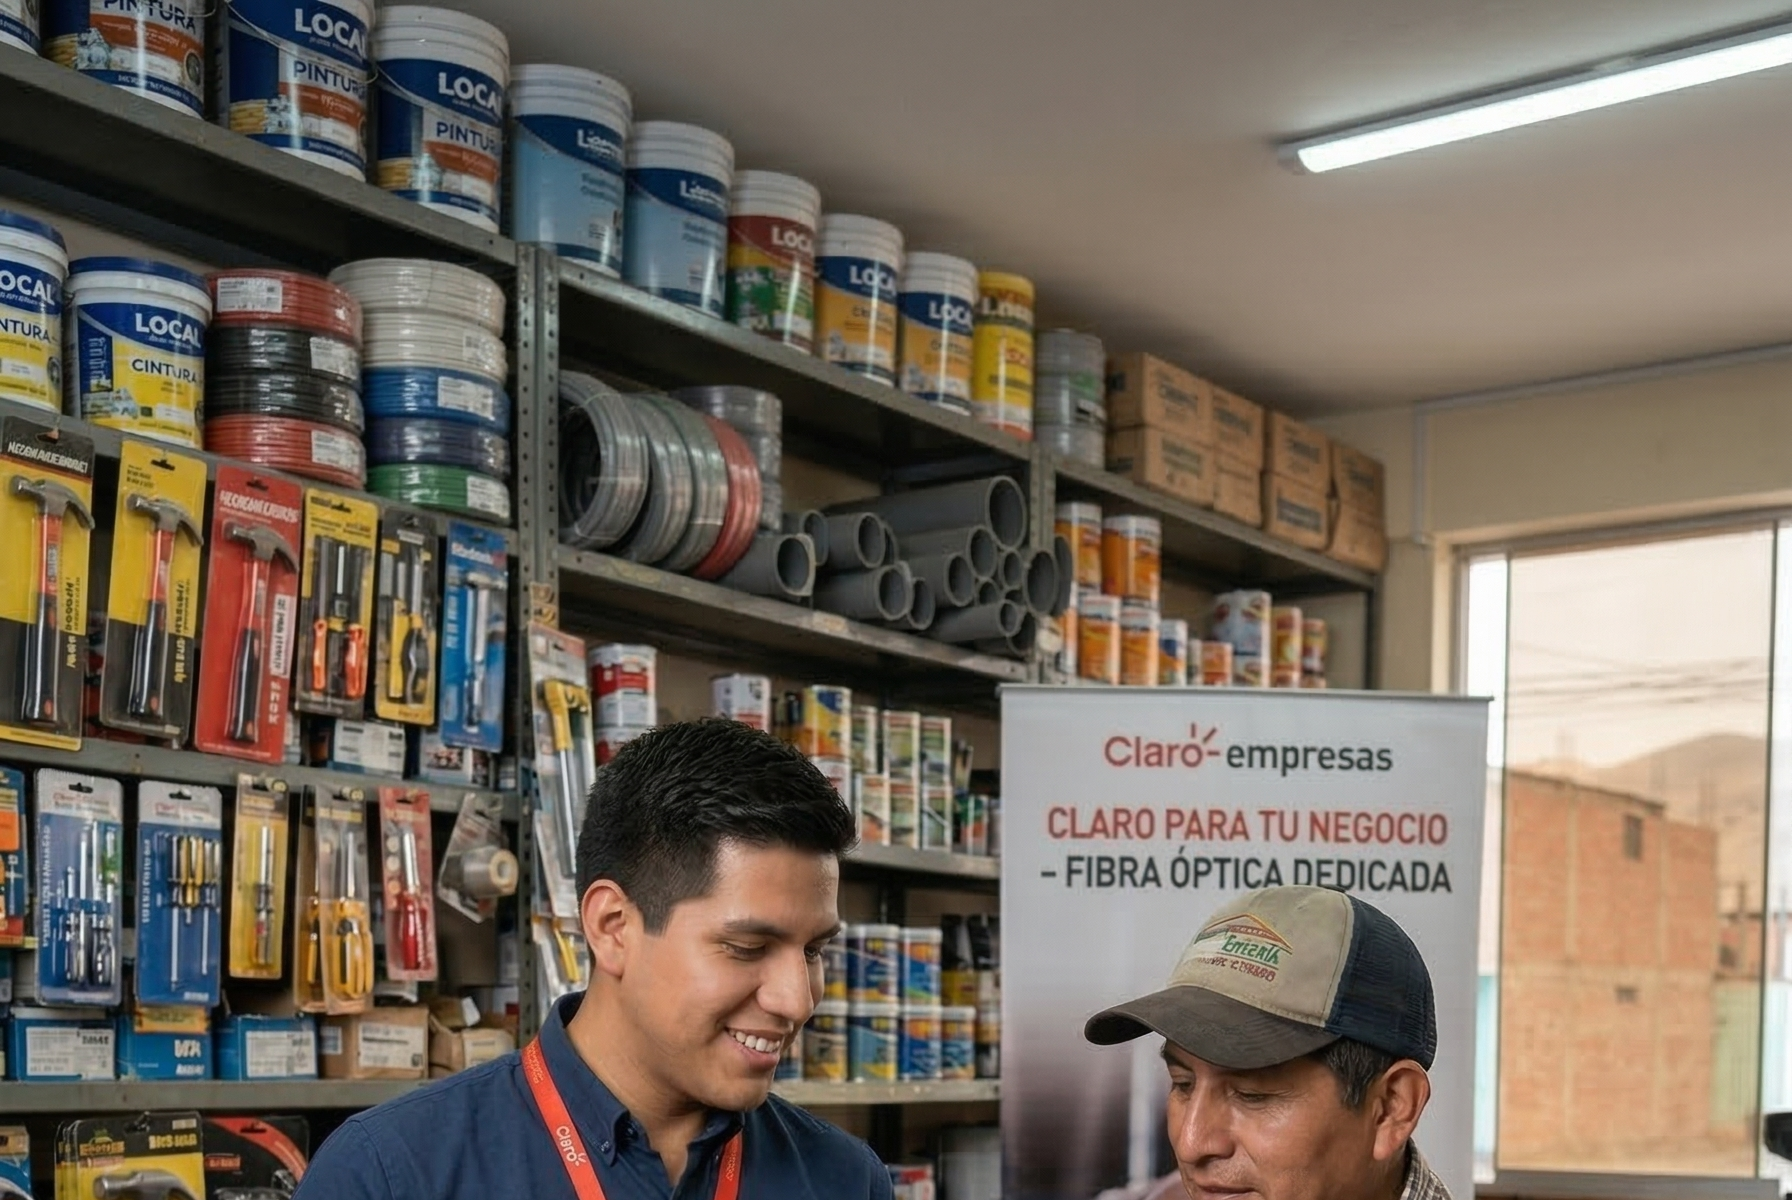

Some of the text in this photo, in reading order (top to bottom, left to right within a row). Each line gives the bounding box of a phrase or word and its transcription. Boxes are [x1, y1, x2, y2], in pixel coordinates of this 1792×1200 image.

[135, 312, 201, 348] LOCAL
[132, 358, 197, 383] CINTURA
[1104, 730, 1393, 777] Claro empresas
[1048, 807, 1448, 845] CLARO PARA TU NEGOCIO
[1066, 856, 1161, 888] FIBRA
[1170, 846, 1284, 889] ÓPTICA
[1295, 859, 1451, 893] DEDICADA
[556, 1126, 583, 1165] Claro
